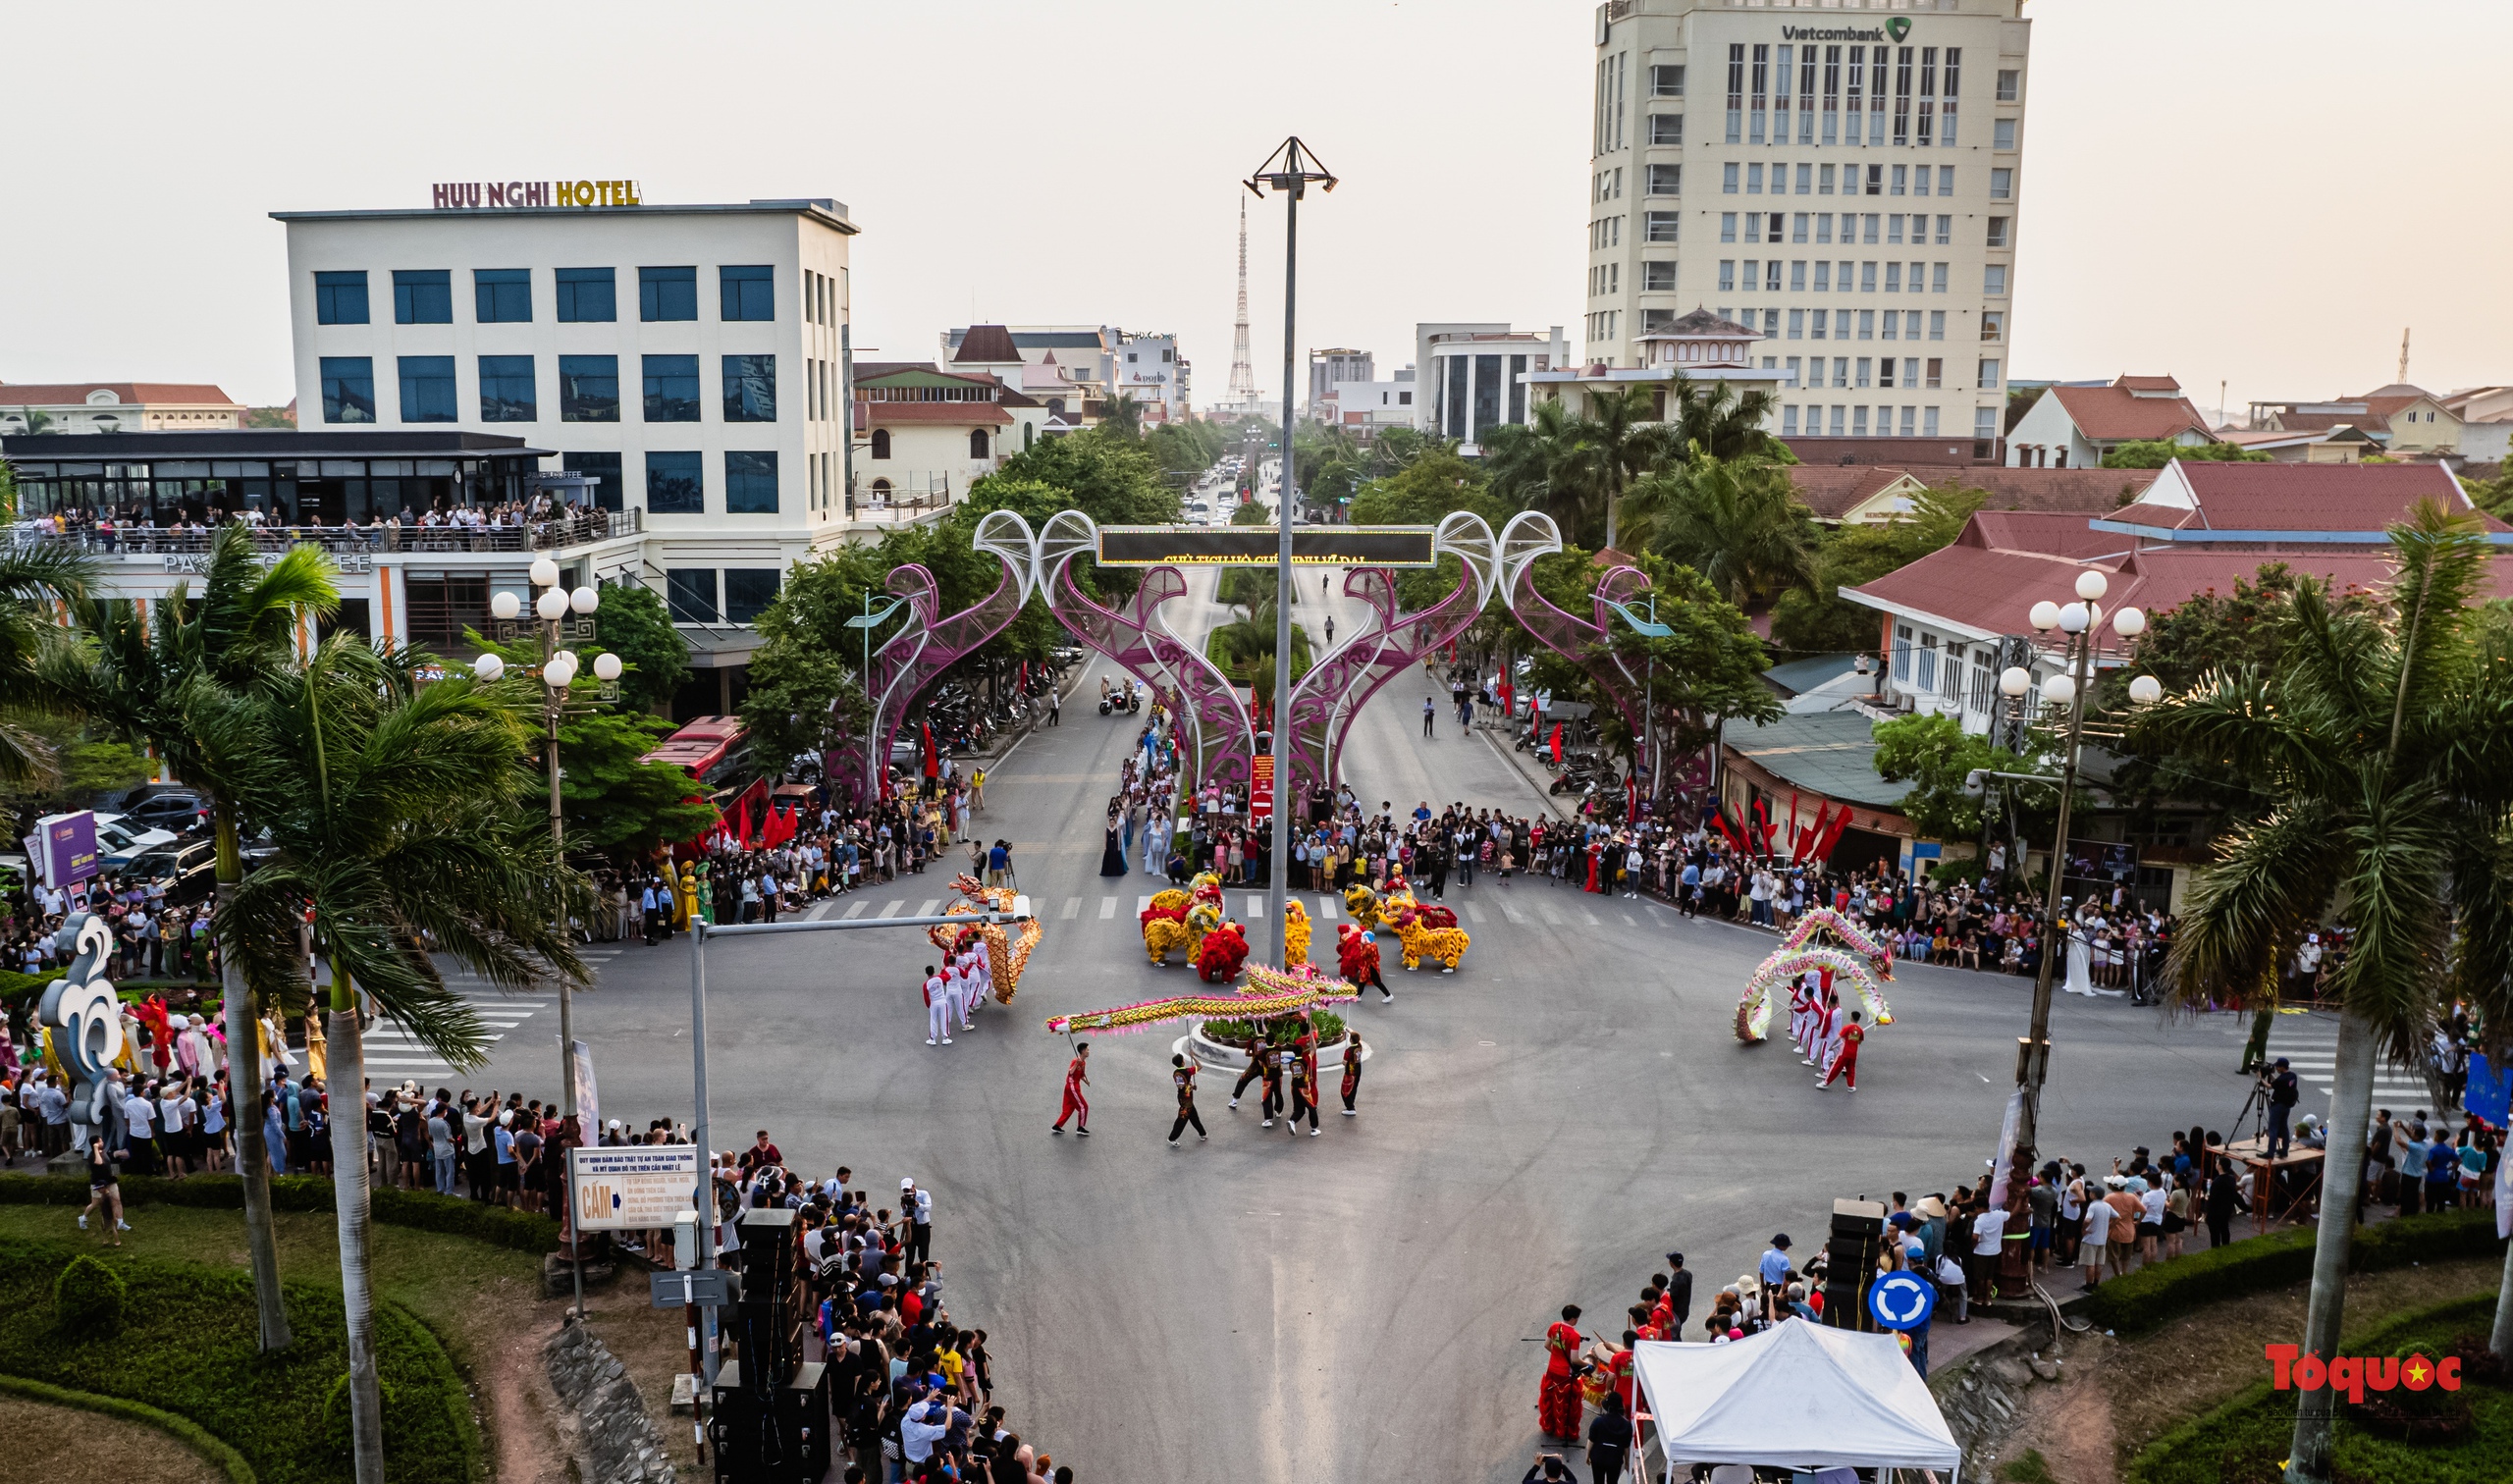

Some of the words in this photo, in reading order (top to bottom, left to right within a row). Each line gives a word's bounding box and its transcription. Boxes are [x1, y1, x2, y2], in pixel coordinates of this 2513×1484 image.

[1782, 25, 1885, 42] Vietcombank
[432, 183, 482, 209] HUU
[488, 181, 551, 207] NGHI
[556, 180, 640, 206] HOTEL
[552, 470, 582, 479] COFFEE
[582, 1180, 613, 1220] CẤM
